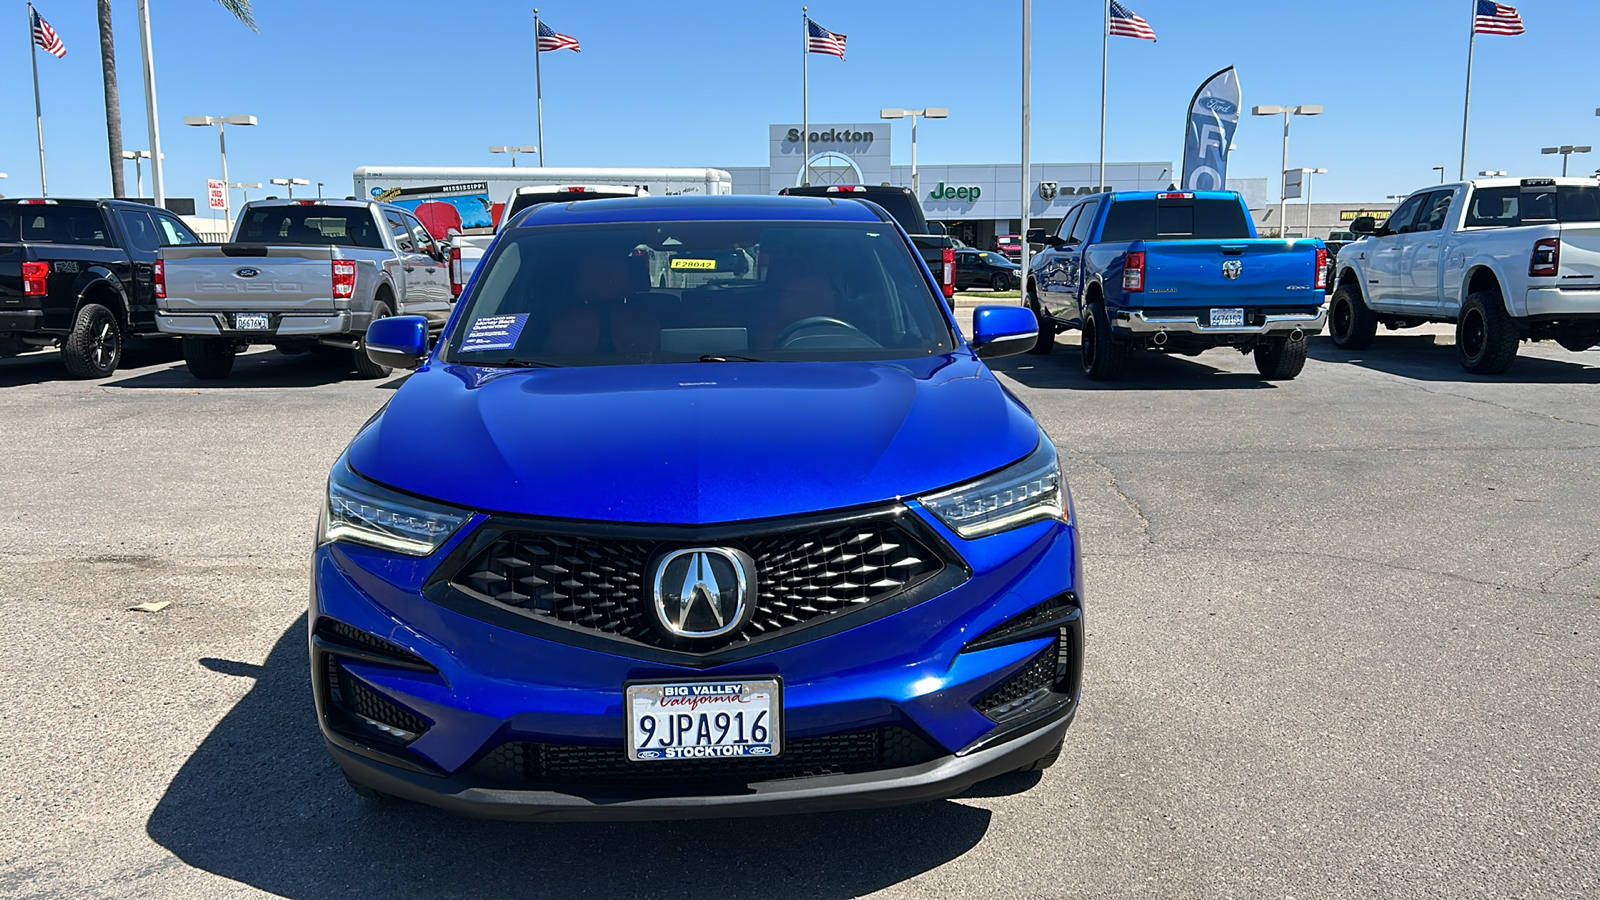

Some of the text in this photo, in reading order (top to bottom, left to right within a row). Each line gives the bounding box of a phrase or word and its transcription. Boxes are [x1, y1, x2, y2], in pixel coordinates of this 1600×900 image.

[1206, 99, 1231, 113] Ford
[787, 128, 874, 143] Stockton
[442, 183, 485, 192] MISSISSIPPI
[930, 181, 981, 202] Jeep
[211, 190, 222, 198] USED
[211, 198, 224, 207] CARS
[54, 261, 79, 273] FX4
[194, 282, 304, 293] F-150
[665, 685, 742, 696] BIG VALLEY
[660, 694, 748, 711] California
[639, 710, 768, 748] 9JPA916
[665, 745, 744, 758] STOCKTON
